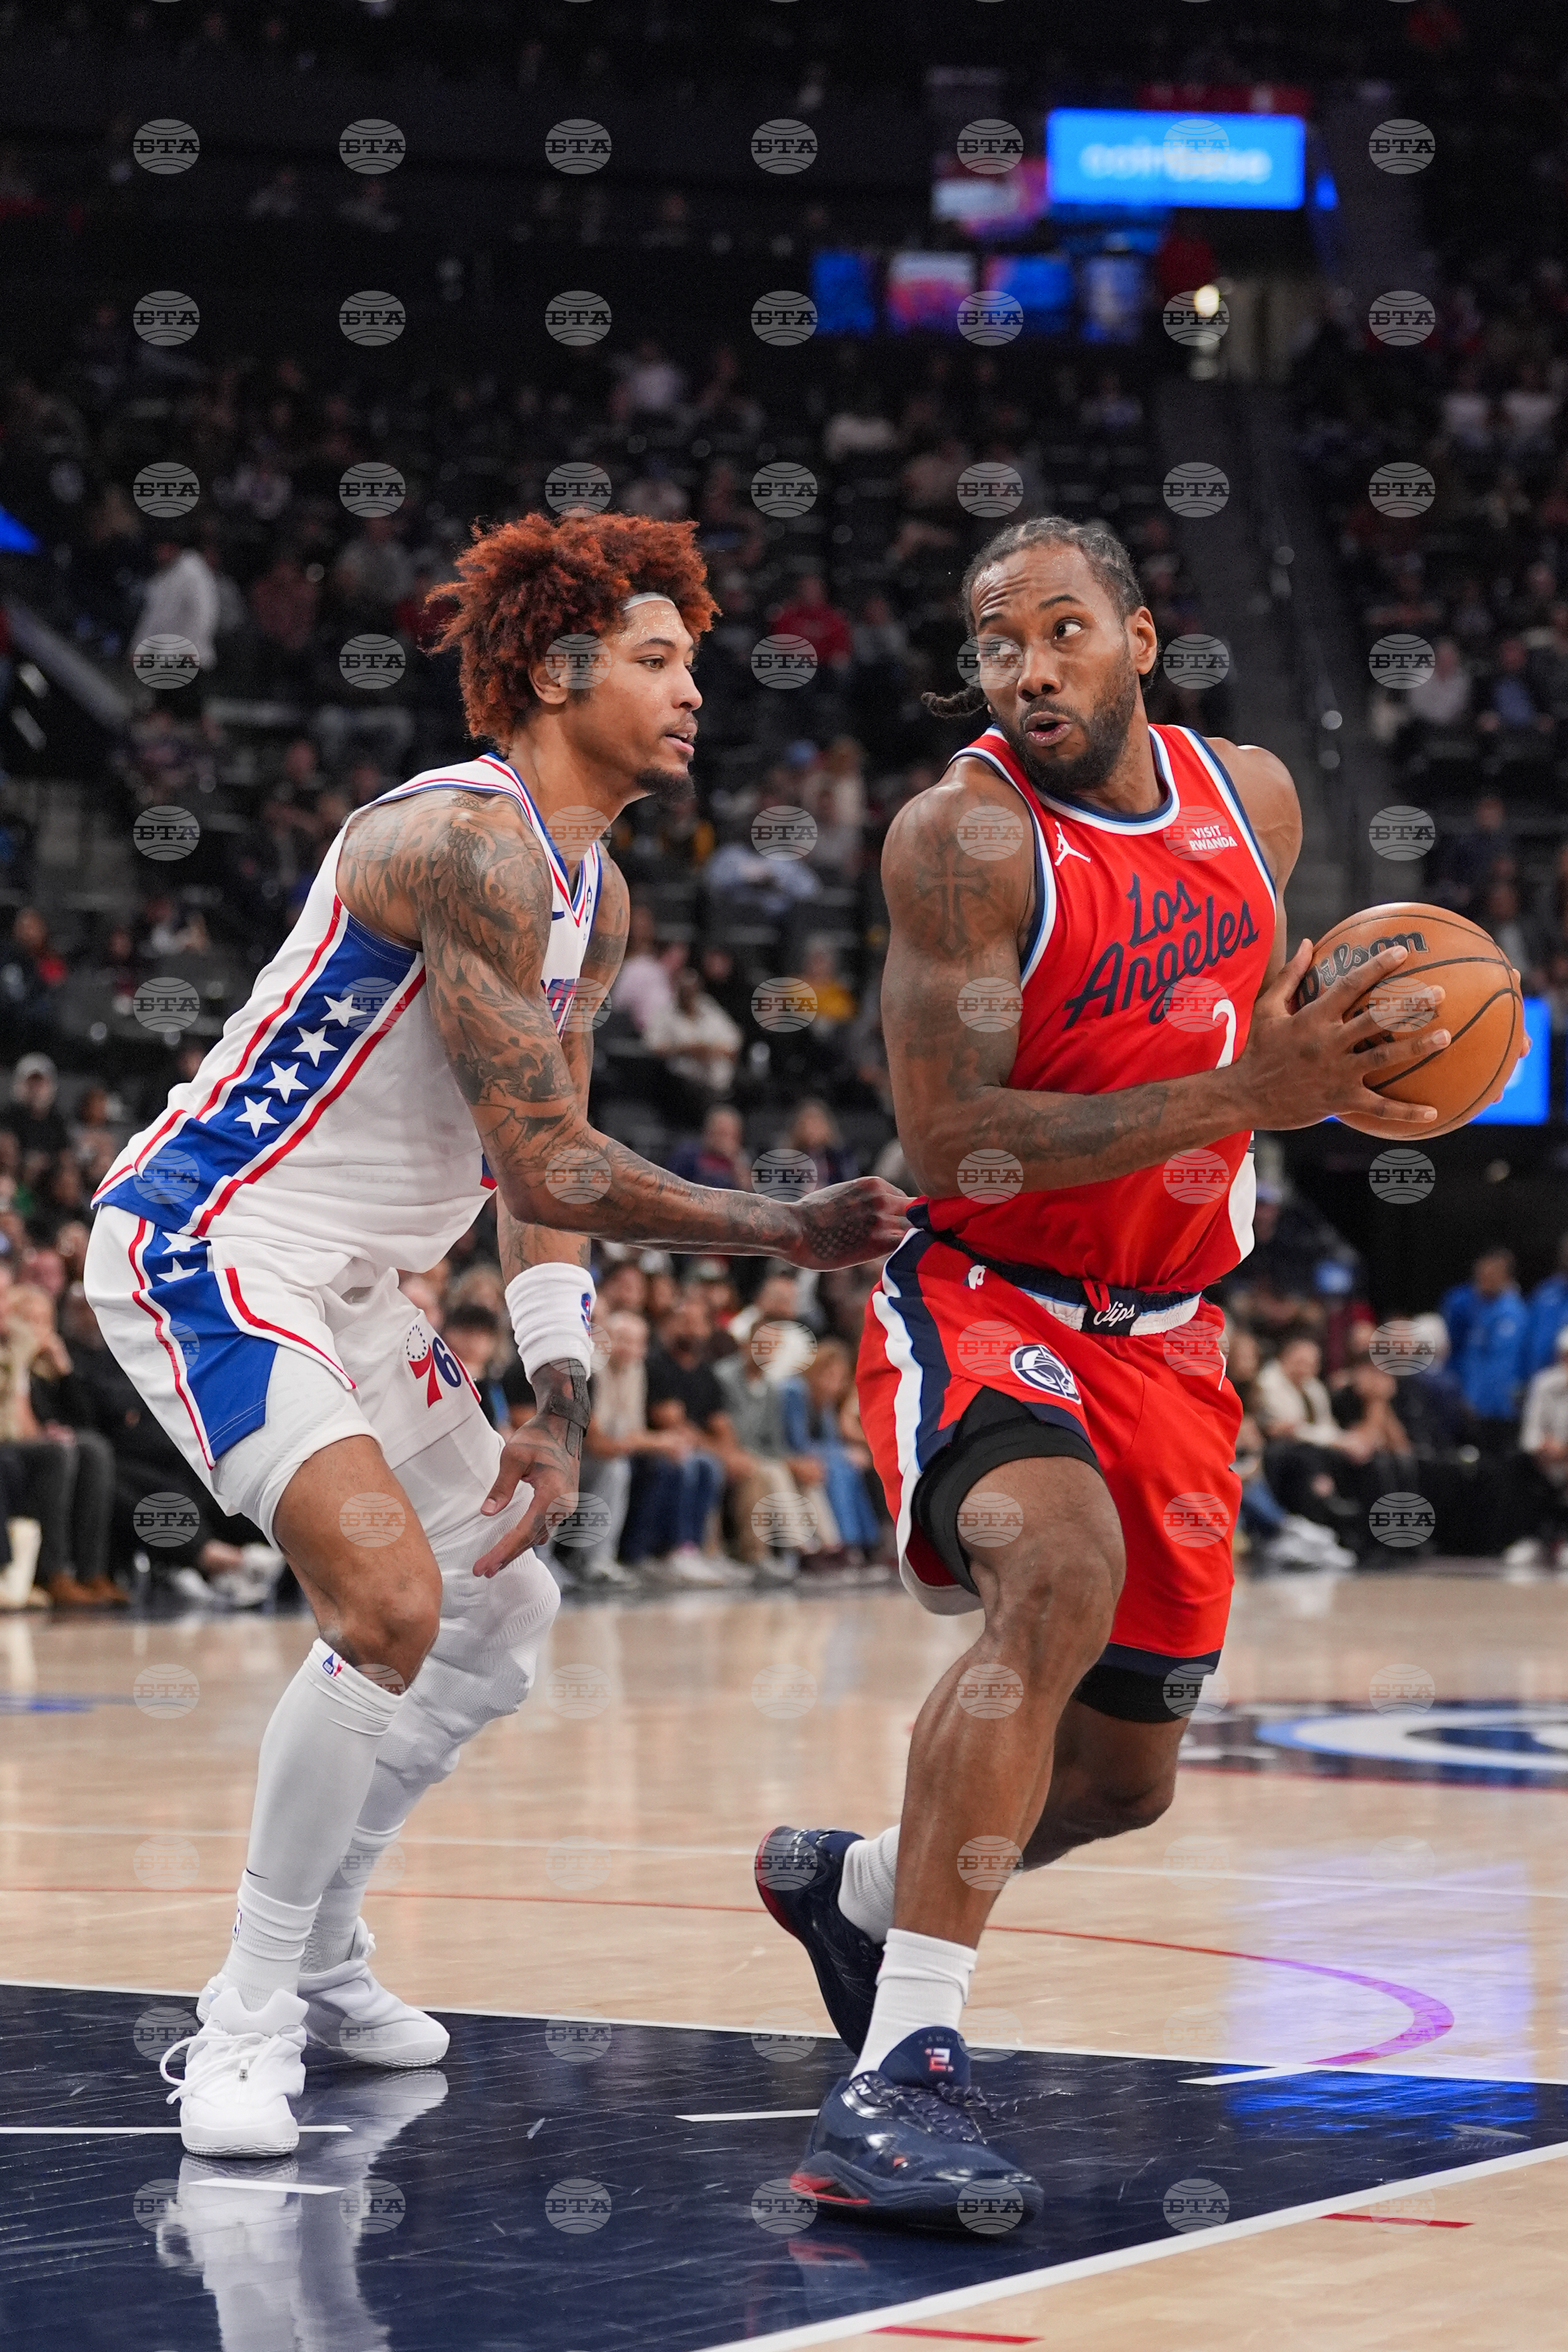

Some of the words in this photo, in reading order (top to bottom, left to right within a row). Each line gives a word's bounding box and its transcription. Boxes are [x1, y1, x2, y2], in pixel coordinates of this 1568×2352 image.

[1189, 835, 1238, 851] RWANDA
[1192, 825, 1222, 839] VISIT
[1126, 872, 1201, 949] Los
[1061, 899, 1260, 1031] Angeles
[1212, 999, 1237, 1069] 2
[1093, 1301, 1136, 1327] Clips
[408, 1336, 462, 1409] 76
